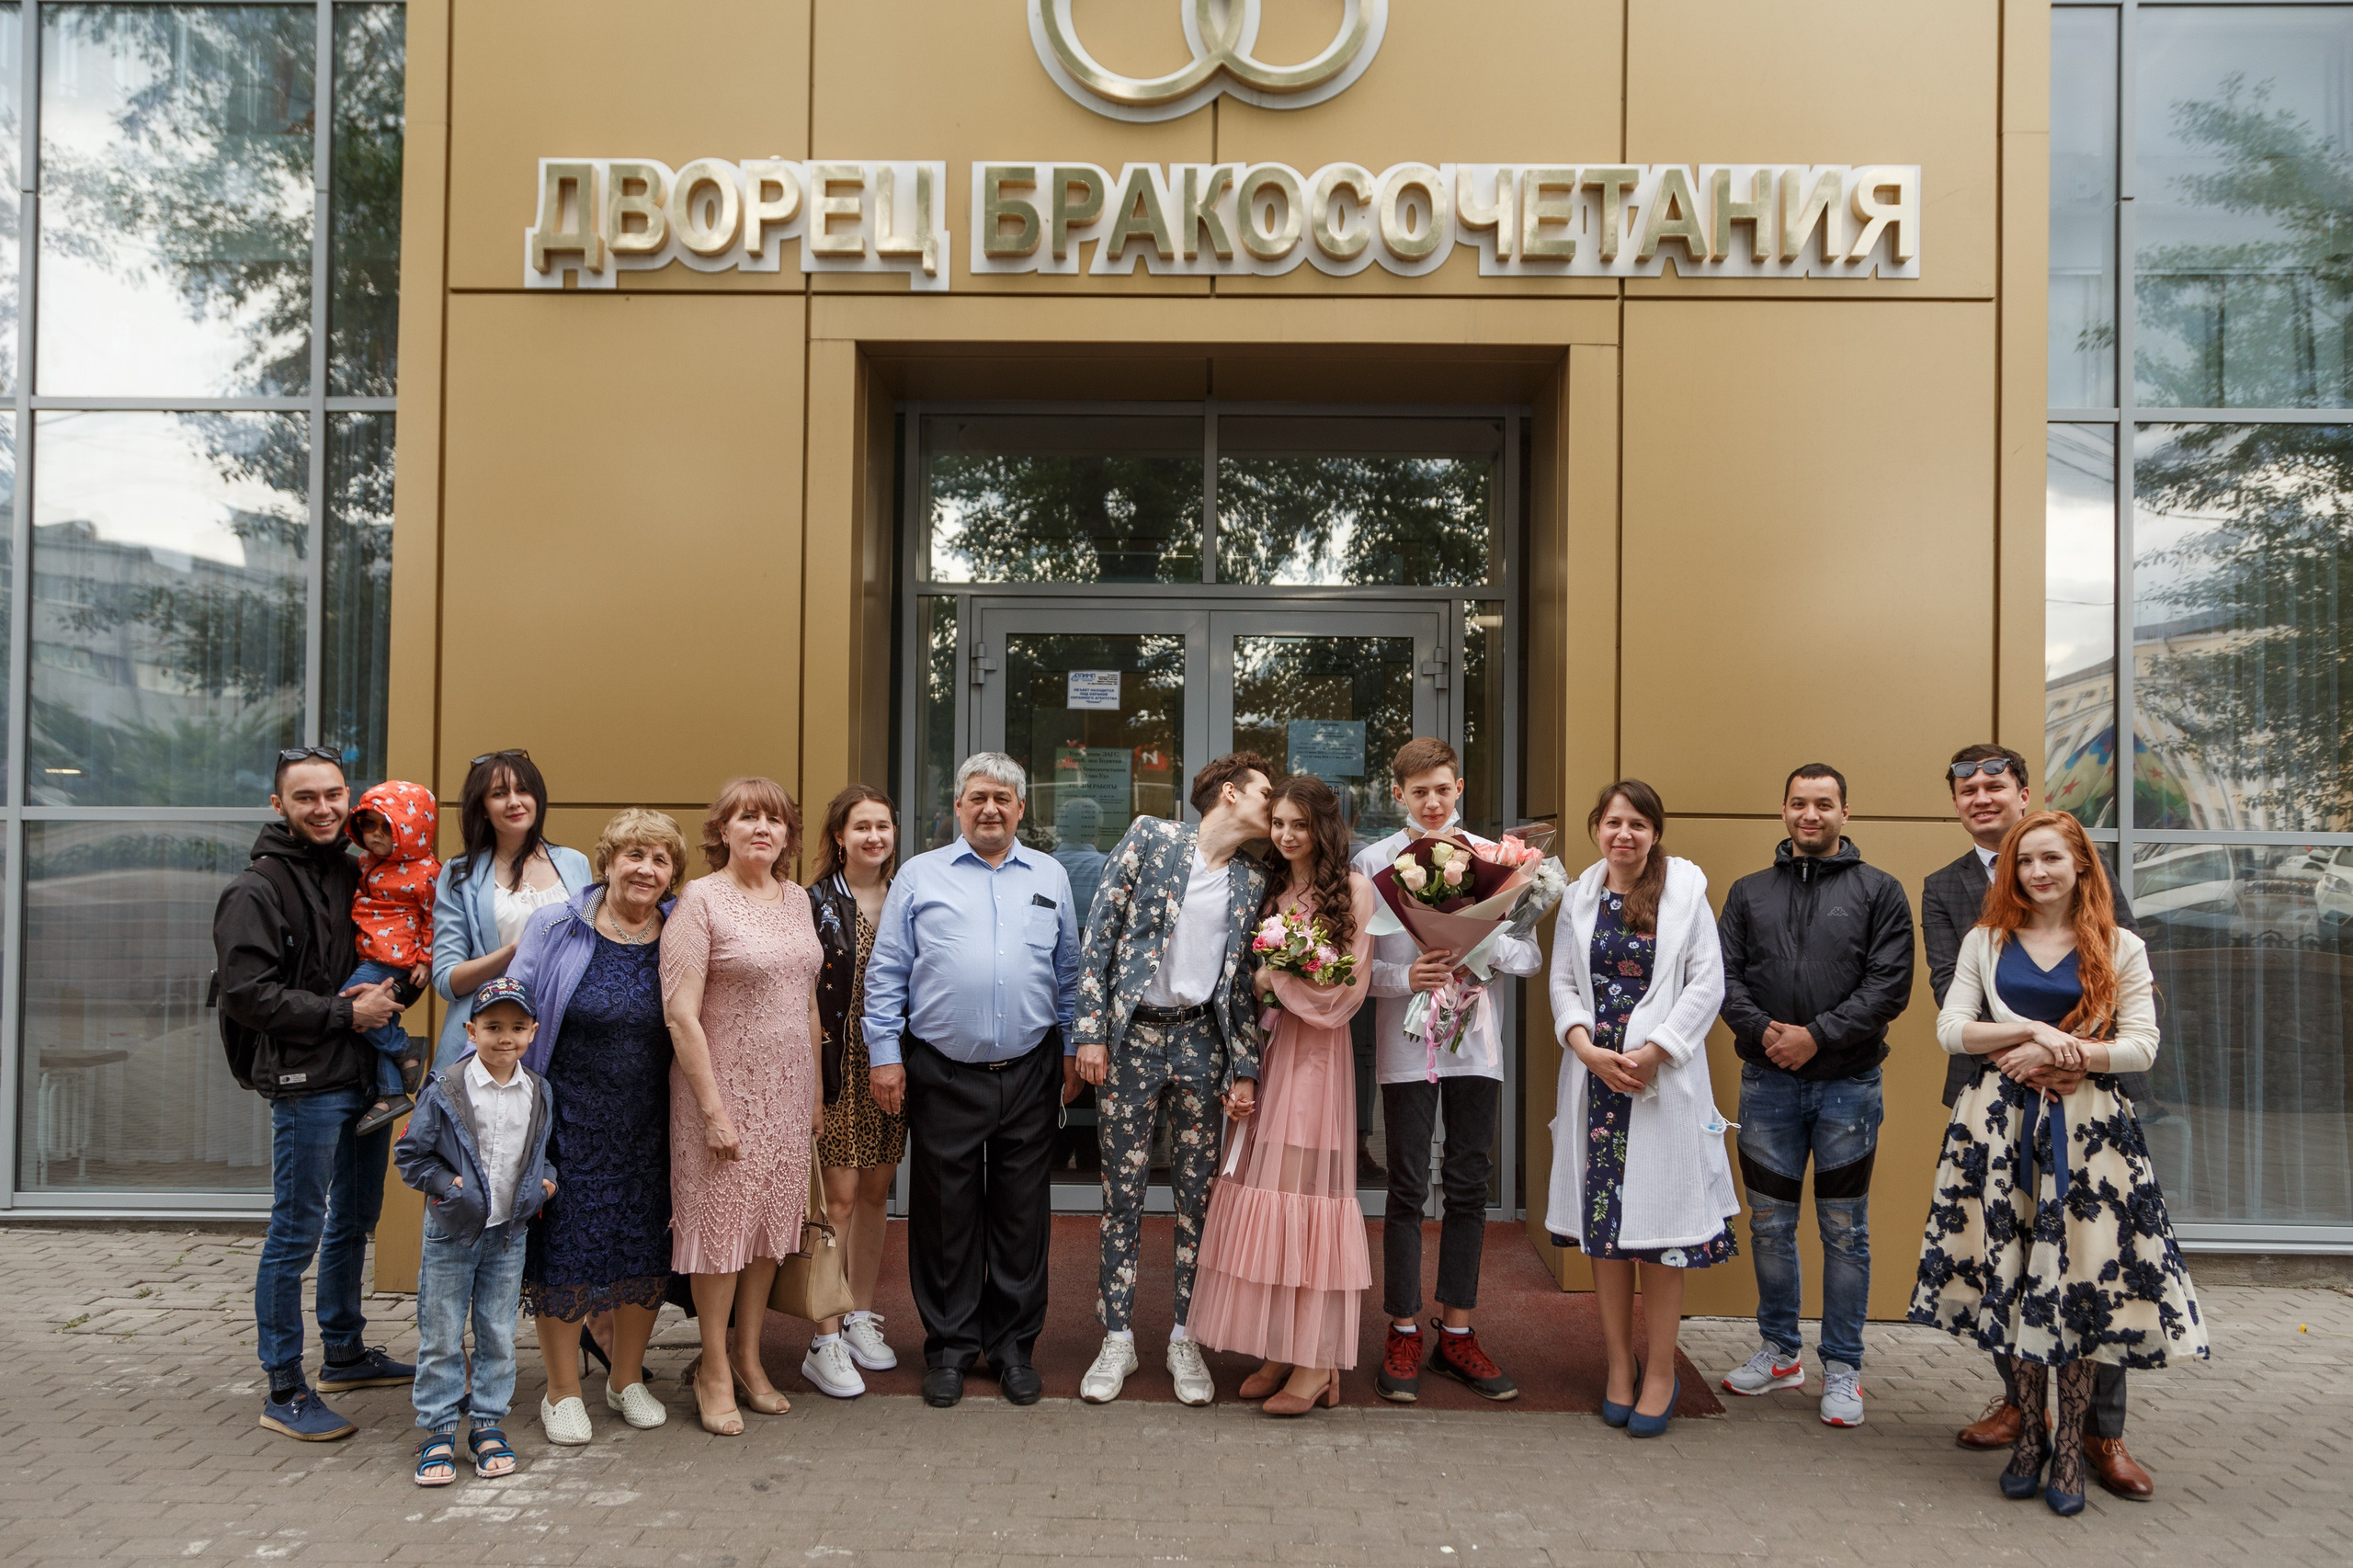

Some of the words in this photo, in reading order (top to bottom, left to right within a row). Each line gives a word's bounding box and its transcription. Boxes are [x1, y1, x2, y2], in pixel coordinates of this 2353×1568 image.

[531, 162, 938, 276] ДВОРЕЦ
[983, 165, 1917, 263] БРАКОСОЧЕТАНИЯ
[1068, 750, 1101, 758] Упраение
